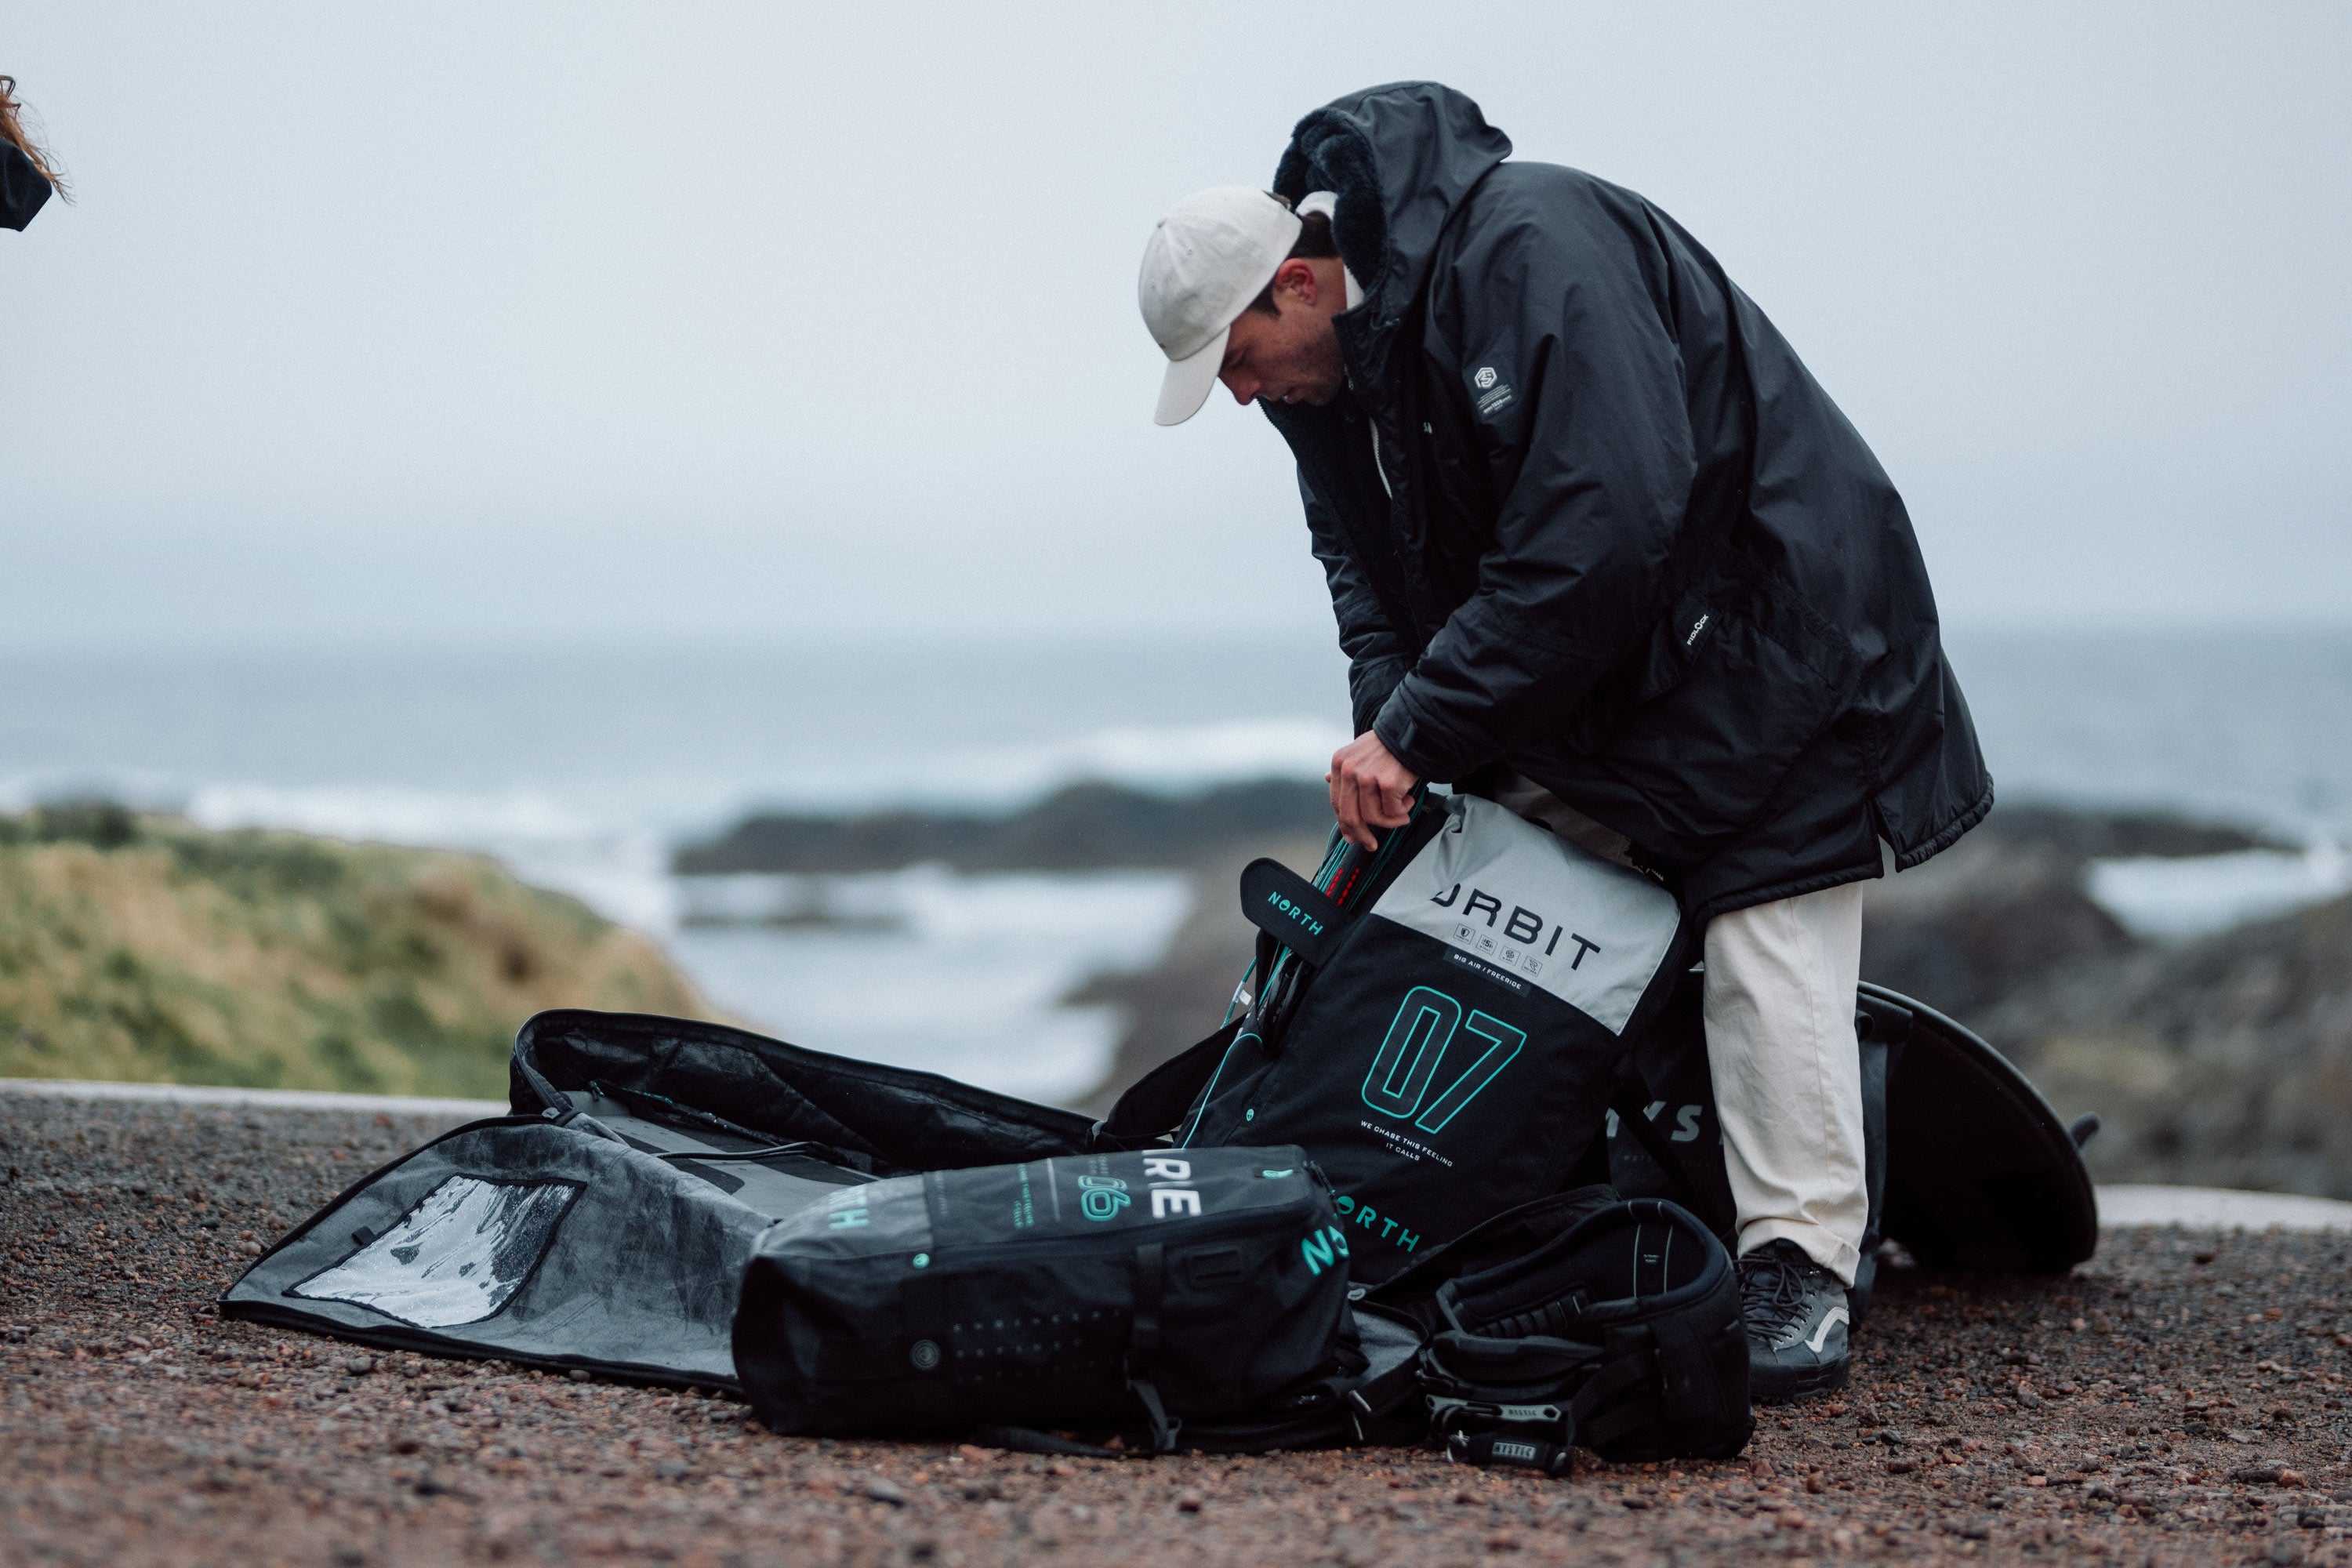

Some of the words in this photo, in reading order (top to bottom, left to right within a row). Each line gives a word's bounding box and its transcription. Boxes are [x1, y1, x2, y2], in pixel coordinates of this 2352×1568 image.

[1686, 614, 1709, 645] FIDLOCK
[1268, 891, 1323, 936] NORTH
[1454, 953, 1468, 963] BIG
[1468, 960, 1481, 970] AIR
[1486, 969, 1522, 989] FREERIDE
[1361, 985, 1527, 1134] 07
[1360, 1120, 1373, 1129] WE
[1374, 1126, 1401, 1142] CHASE
[1403, 1138, 1421, 1149] THIS
[1421, 1146, 1454, 1167] FEELING
[1396, 1146, 1421, 1161] CALLS
[1078, 1174, 1131, 1221] 06
[1332, 1189, 1420, 1253] ORTH
